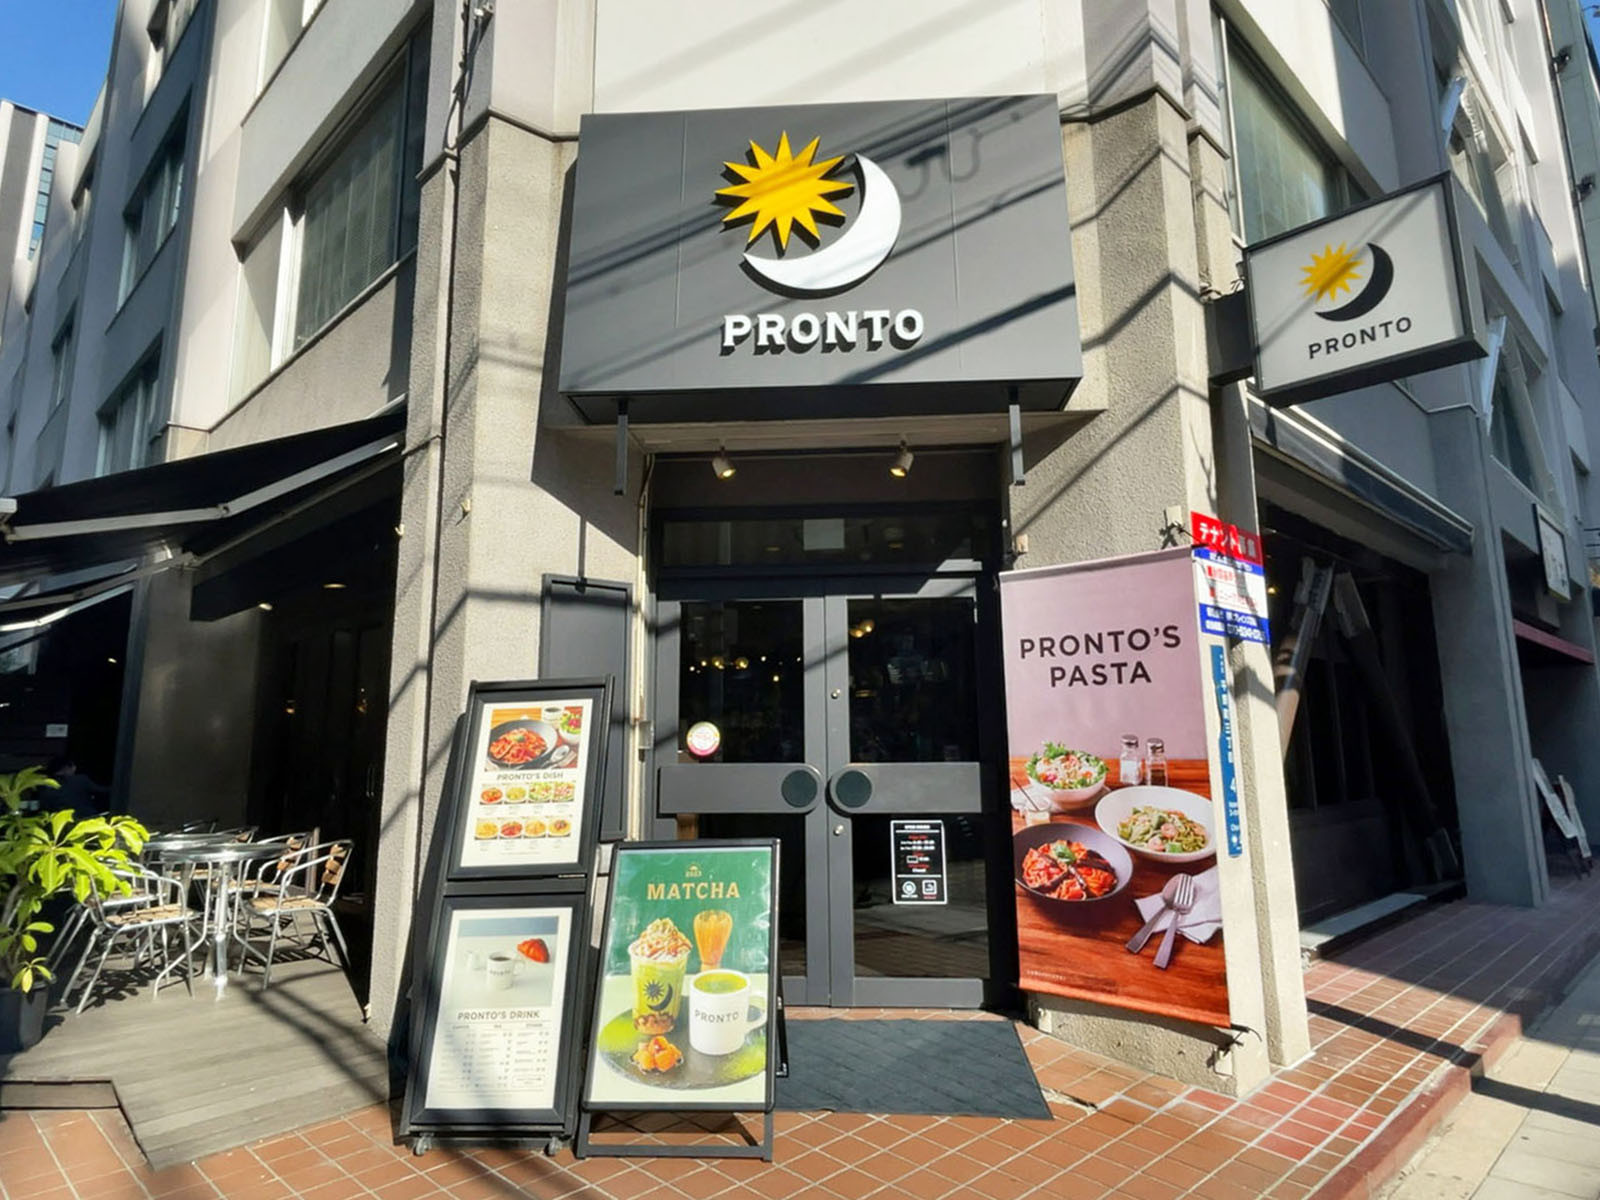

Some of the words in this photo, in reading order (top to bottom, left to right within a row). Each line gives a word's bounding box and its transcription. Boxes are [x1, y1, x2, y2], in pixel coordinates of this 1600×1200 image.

[721, 308, 925, 351] PRONTO
[1308, 317, 1412, 359] PRONTO
[1020, 625, 1181, 659] PRONTO'S
[1050, 661, 1152, 688] PASTA
[543, 771, 564, 779] DISH
[647, 881, 740, 900] MATCHA
[457, 1010, 507, 1021] PRONTO'S
[509, 1009, 541, 1020] DRINK
[694, 1009, 740, 1025] PRONTO
